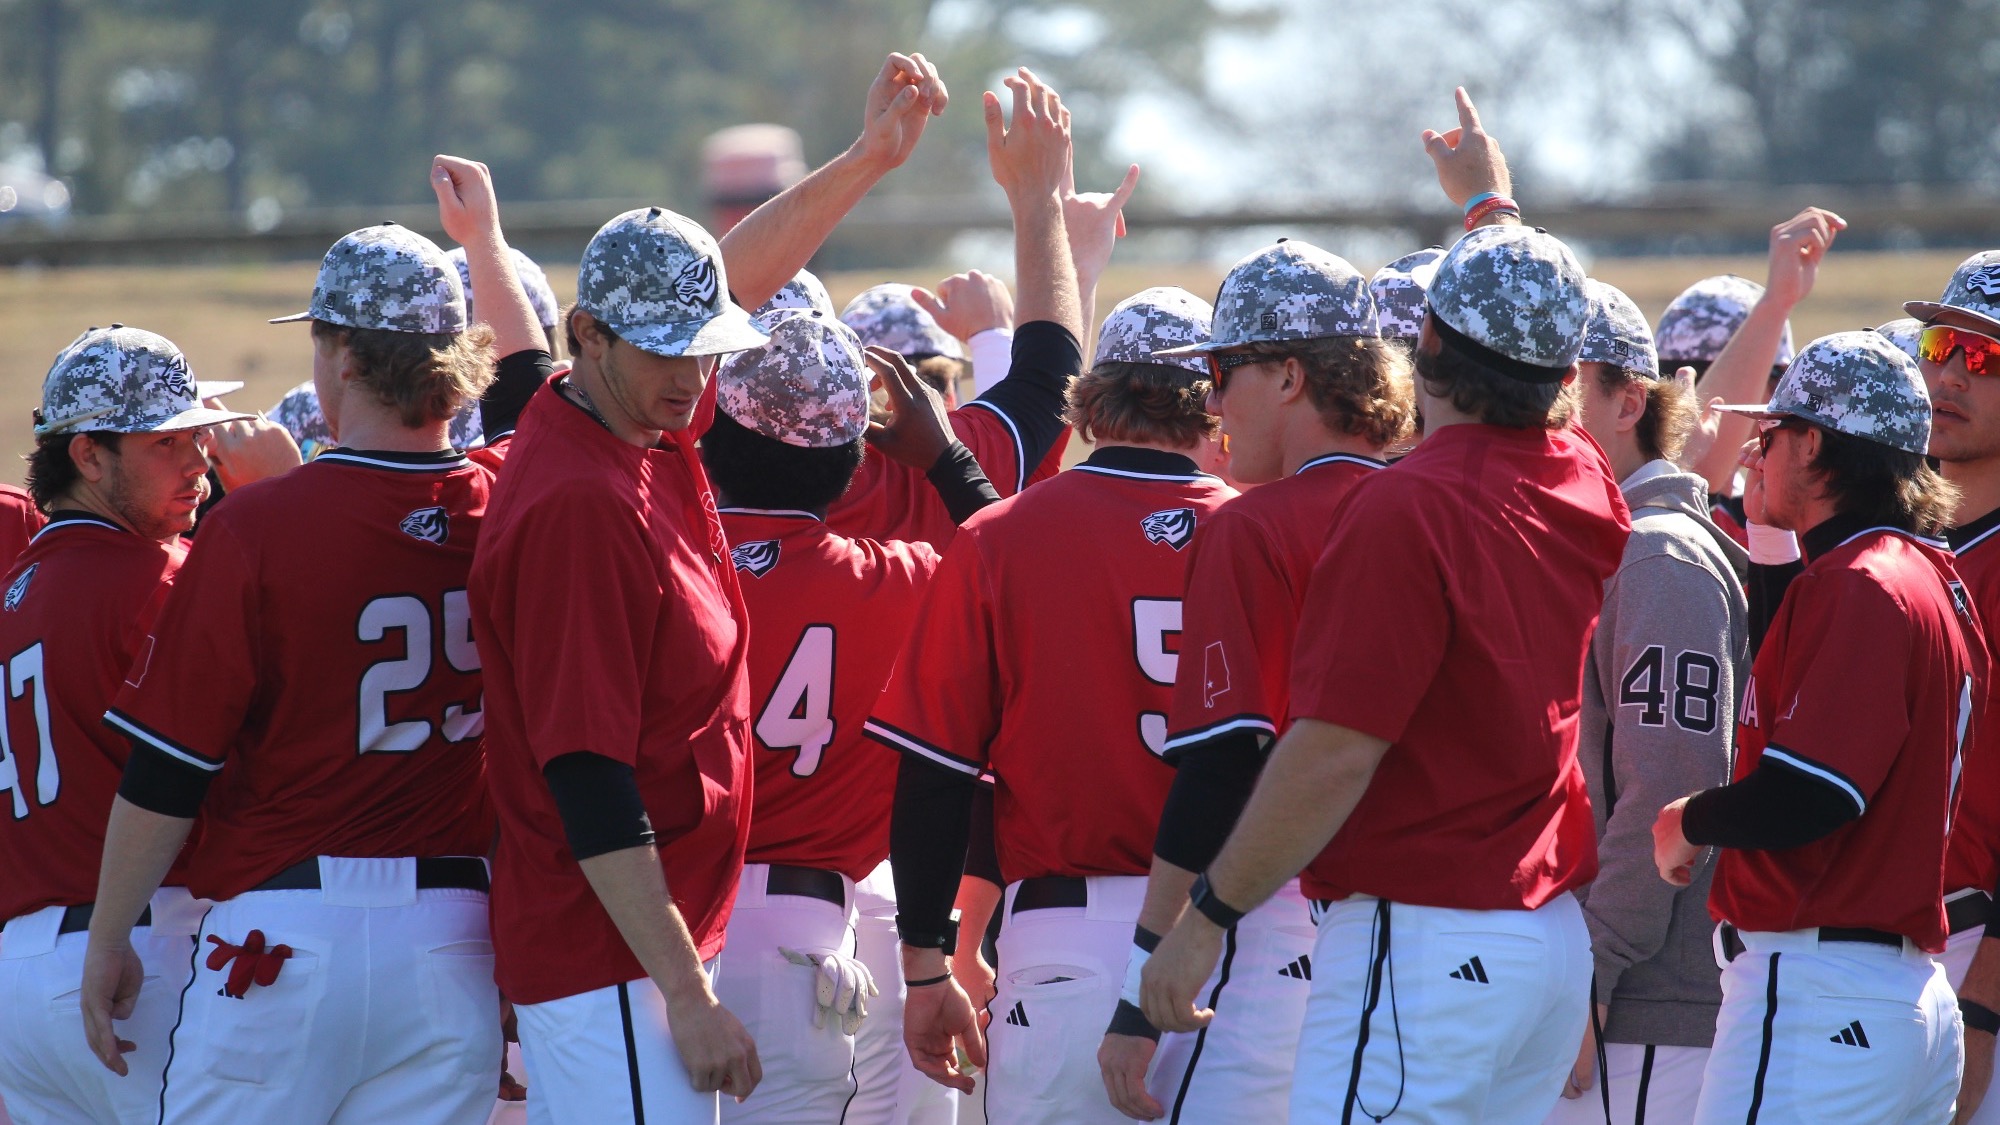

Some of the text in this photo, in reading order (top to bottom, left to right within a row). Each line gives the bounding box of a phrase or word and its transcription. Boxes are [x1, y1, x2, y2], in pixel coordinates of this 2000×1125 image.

[356, 587, 486, 757] 25
[754, 623, 837, 778] 4
[1131, 596, 1183, 758] 5
[1619, 644, 1721, 736] 48
